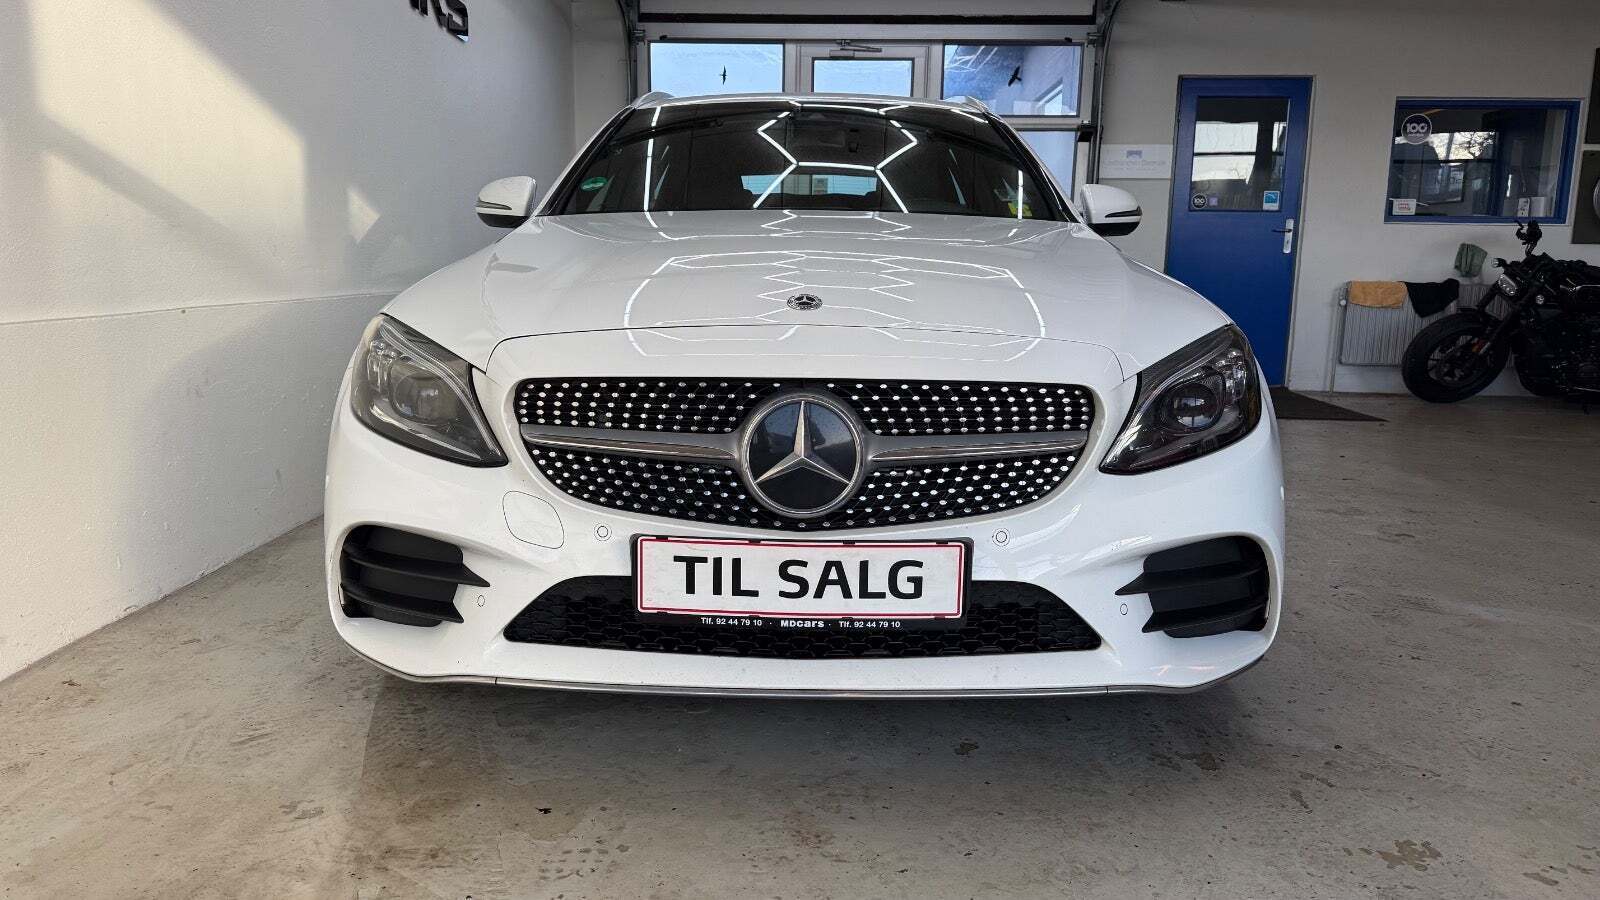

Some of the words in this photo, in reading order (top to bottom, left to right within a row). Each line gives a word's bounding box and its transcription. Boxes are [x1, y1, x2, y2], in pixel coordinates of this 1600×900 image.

[673, 555, 759, 597] TIL
[778, 559, 924, 600] SALG
[716, 617, 726, 625] 92
